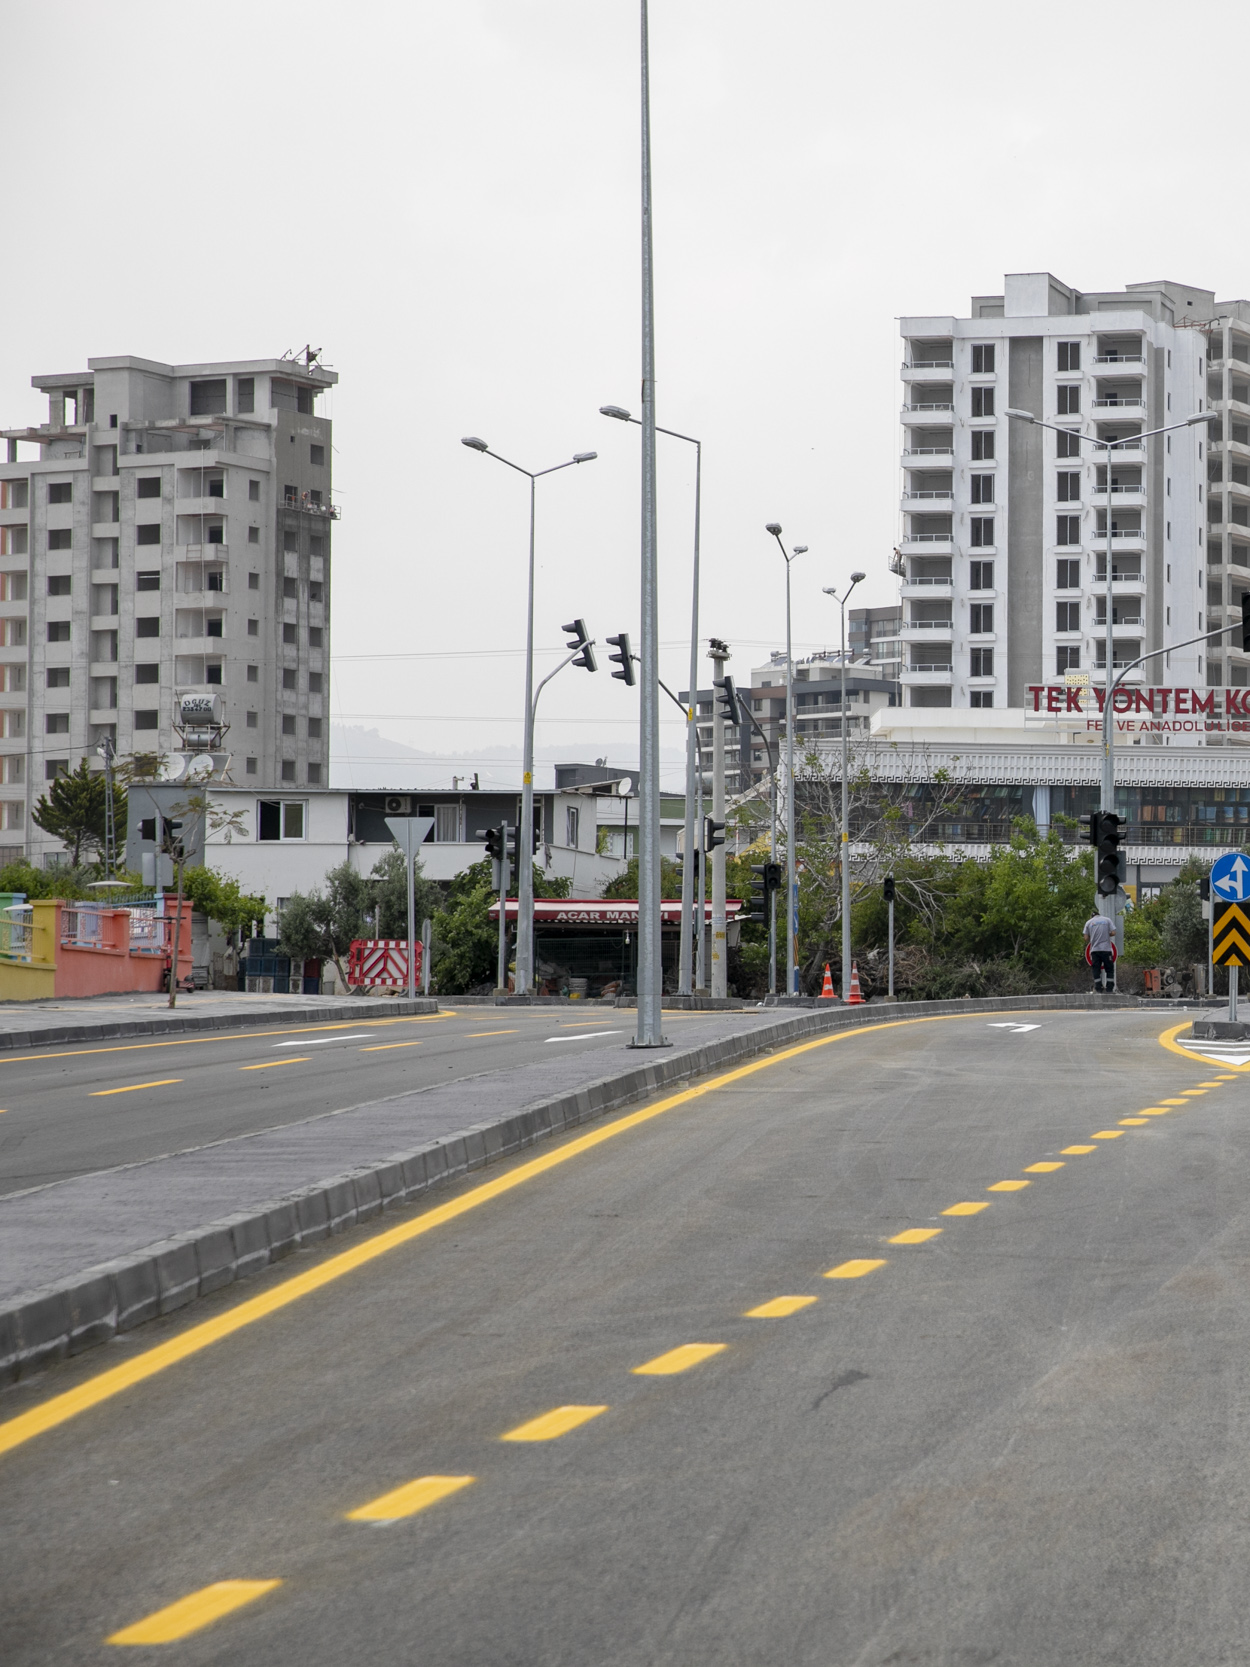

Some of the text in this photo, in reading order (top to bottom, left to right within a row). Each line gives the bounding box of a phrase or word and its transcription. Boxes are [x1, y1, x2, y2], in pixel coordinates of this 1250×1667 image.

[1028, 686, 1083, 713] TEK
[1092, 683, 1214, 715] YÖNTEM
[1086, 720, 1107, 731] FE
[1116, 720, 1135, 732] VE
[1139, 720, 1214, 732] ANADOLU
[556, 911, 668, 920] ACAR MANI
